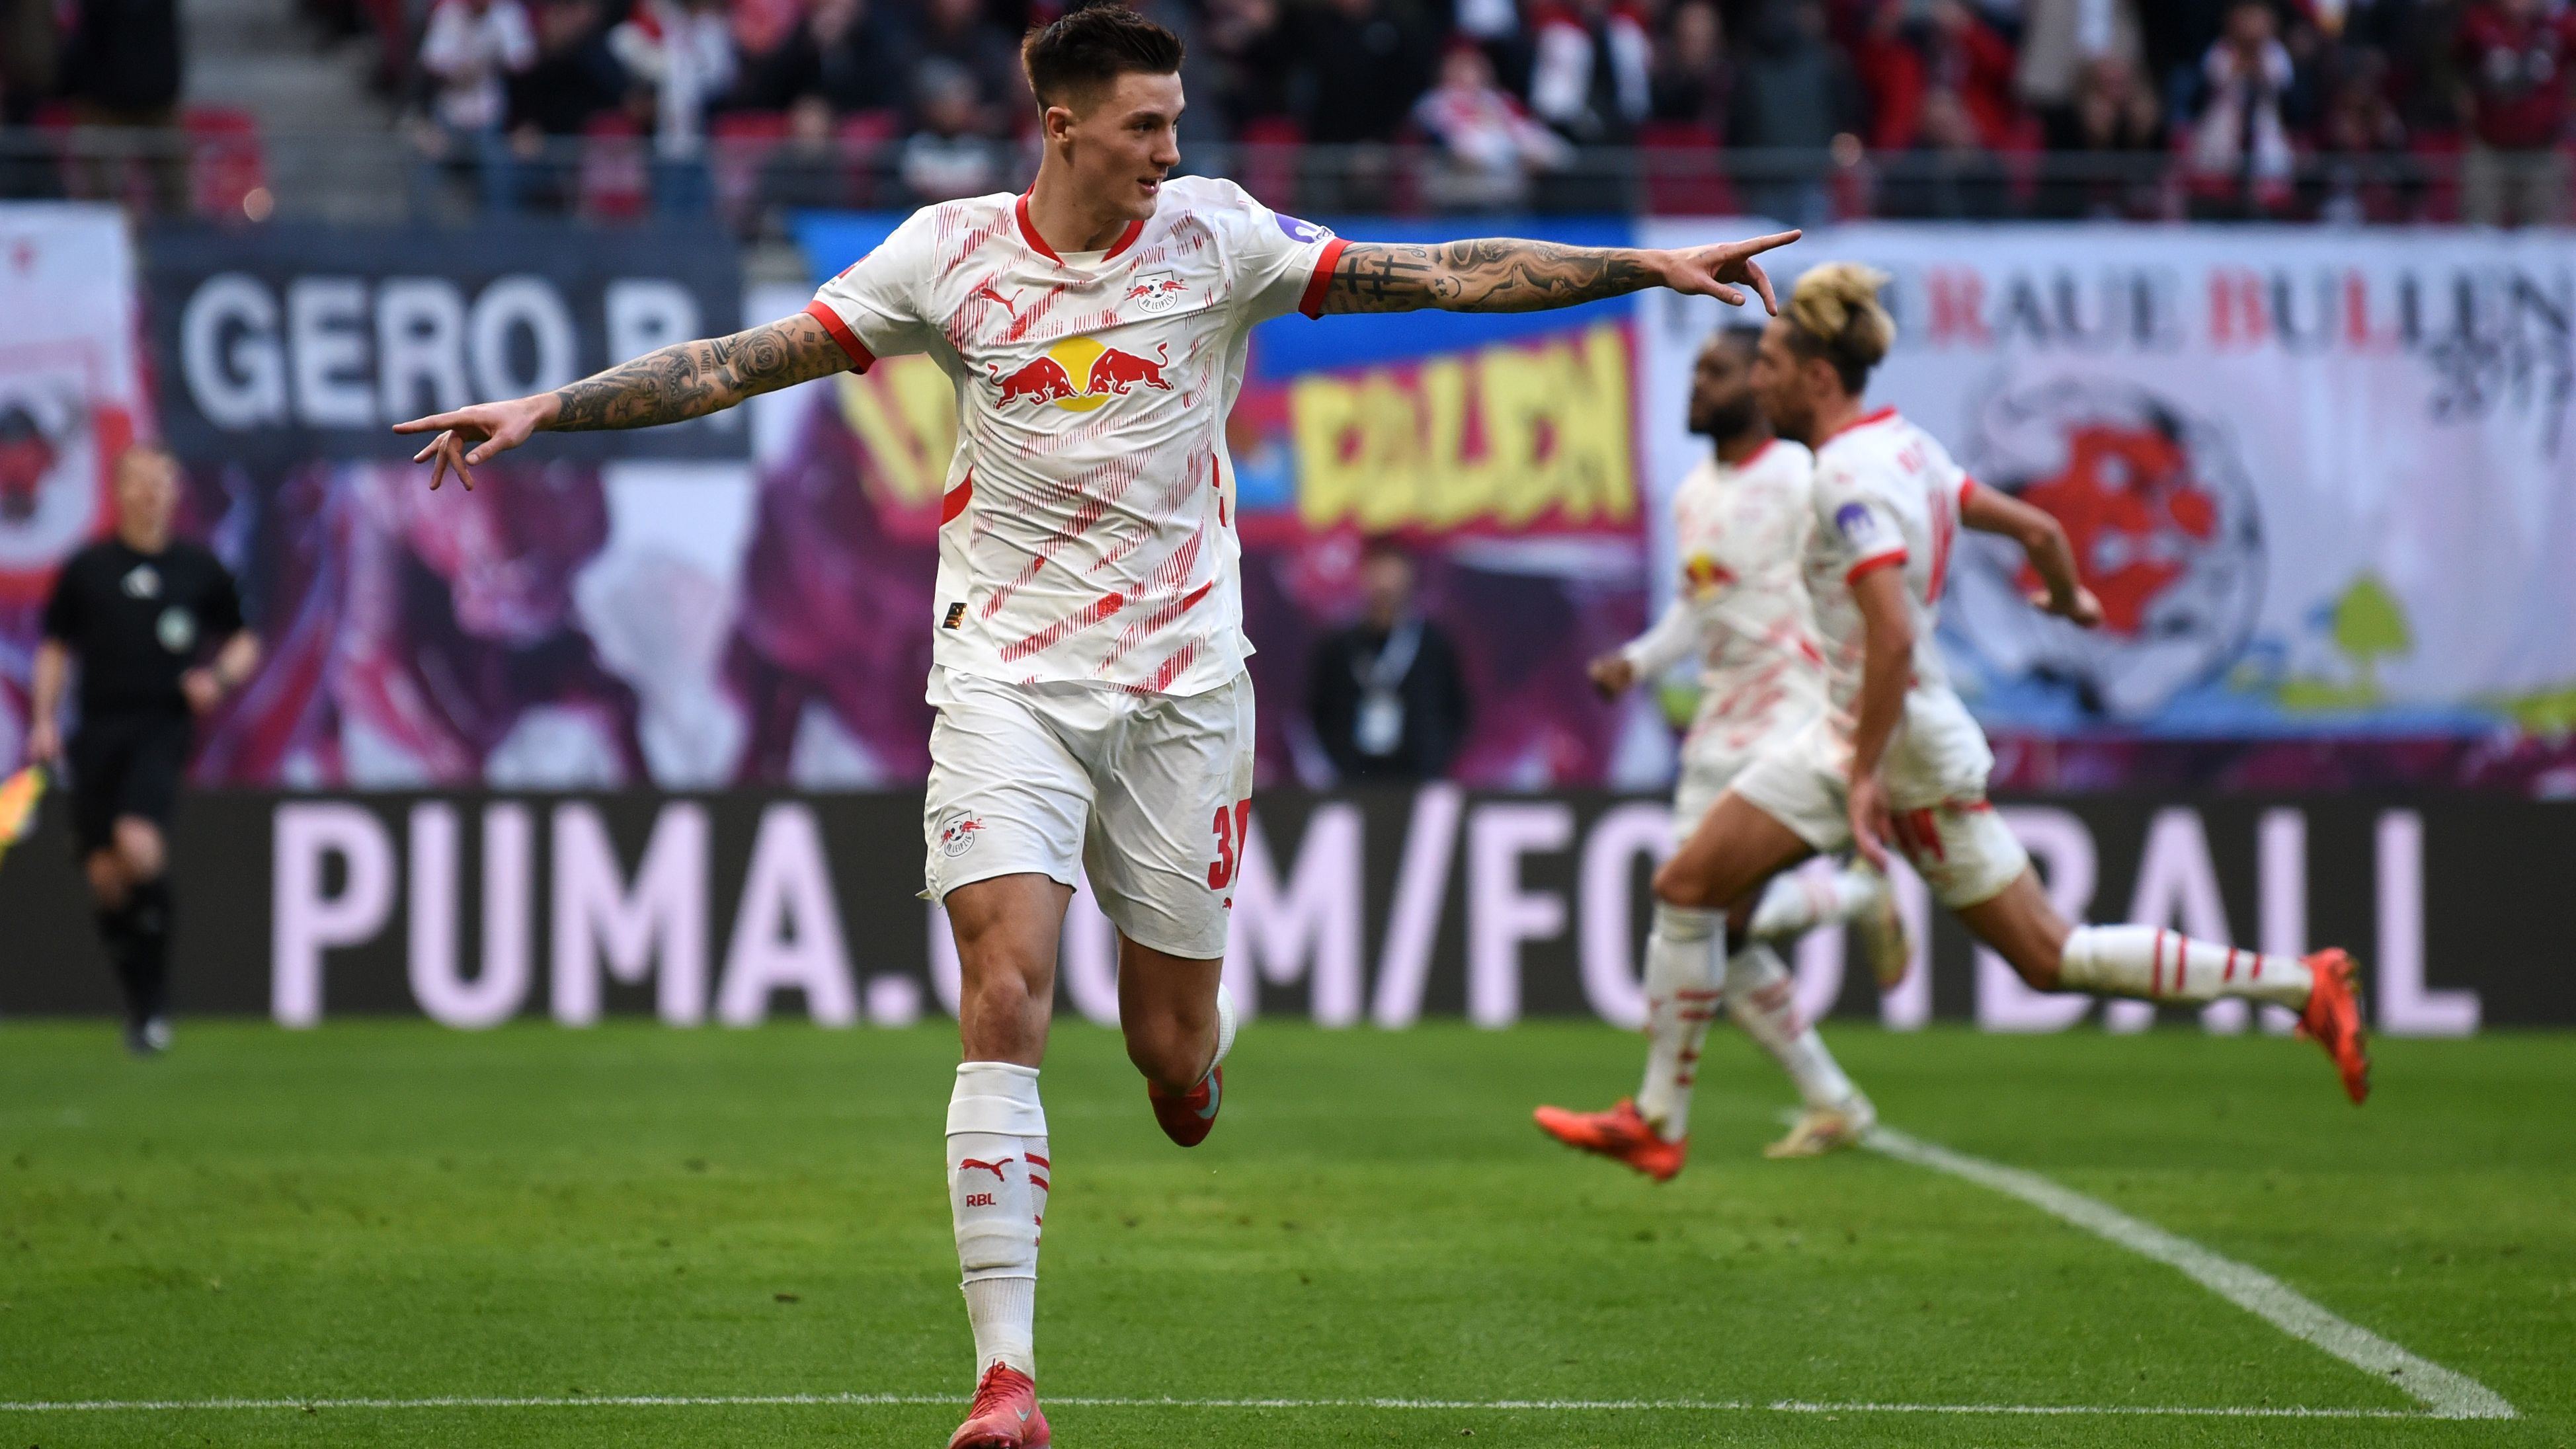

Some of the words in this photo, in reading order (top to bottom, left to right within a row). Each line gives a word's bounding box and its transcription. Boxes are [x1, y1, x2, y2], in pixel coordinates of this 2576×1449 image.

[1151, 294, 1174, 309] LEIPZIG
[181, 272, 575, 431] GERO
[952, 836, 972, 853] LEIPZIG
[271, 785, 2481, 1037] PUMA.M/FOBALL
[966, 1193, 996, 1207] RBL
